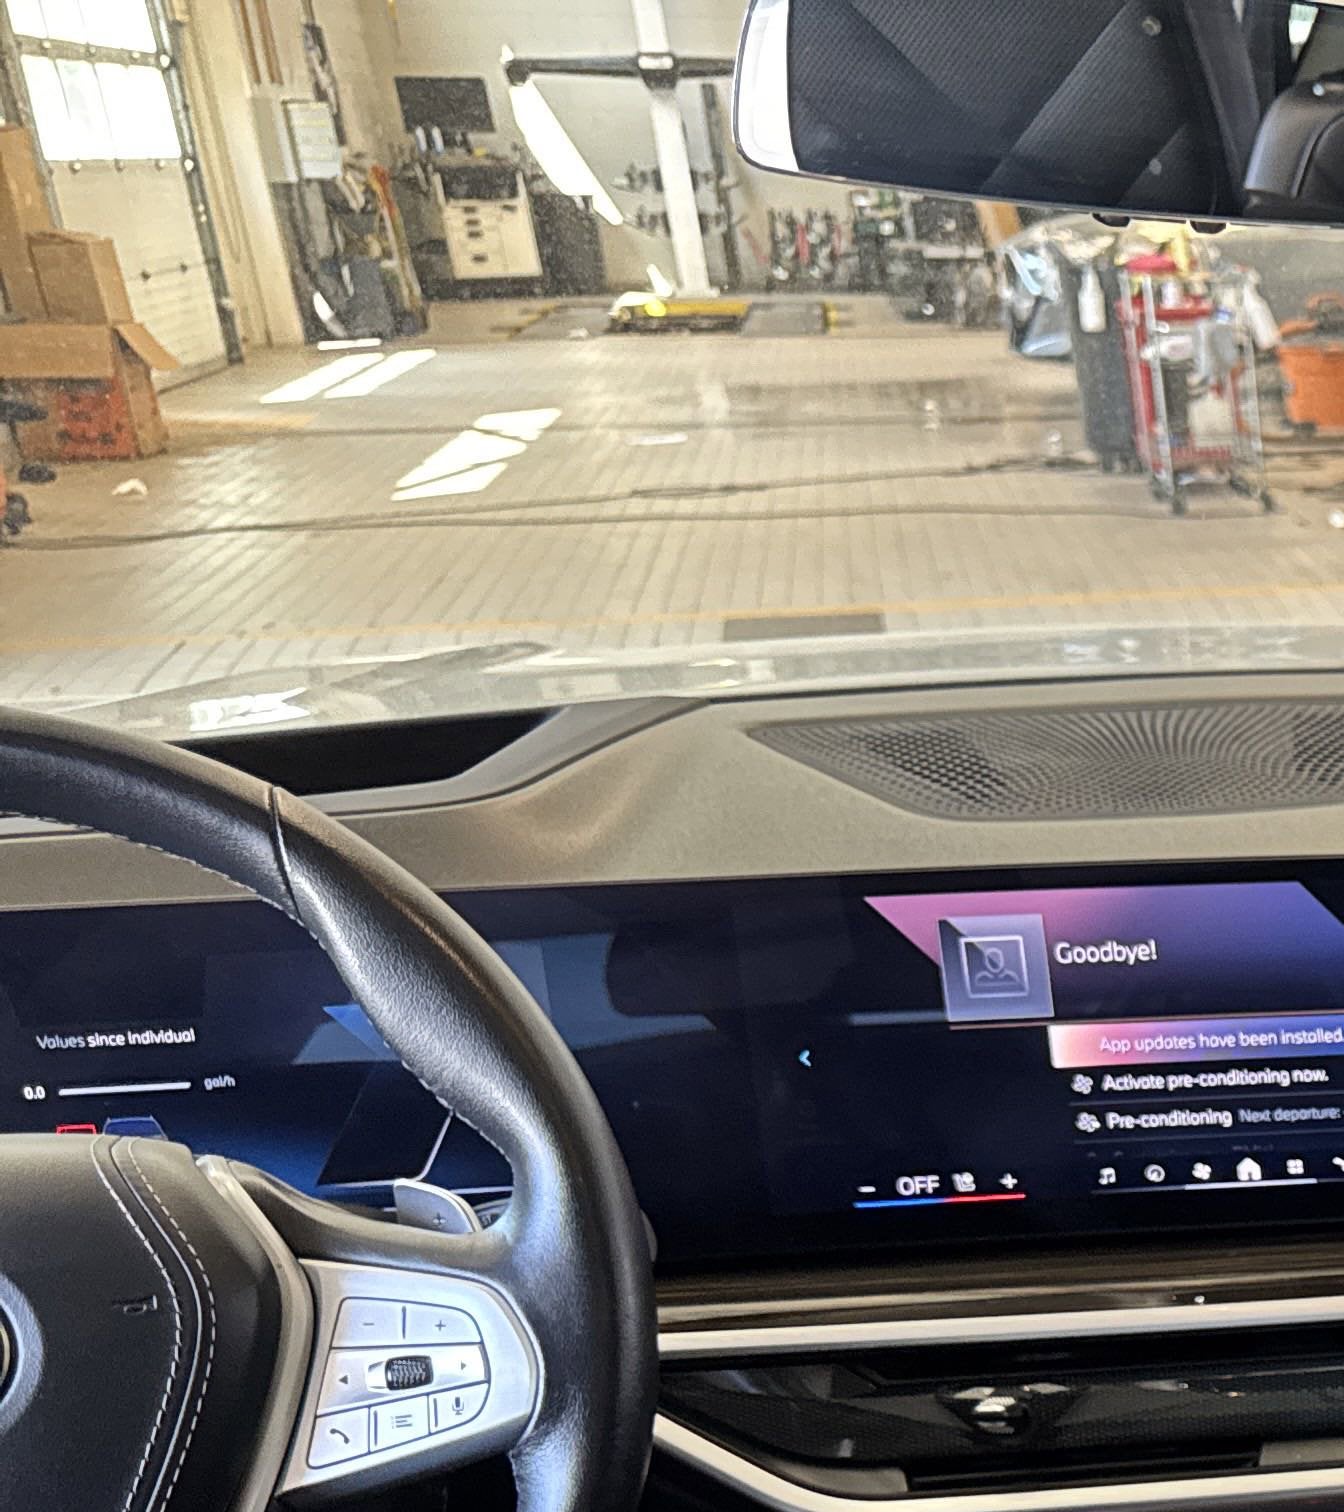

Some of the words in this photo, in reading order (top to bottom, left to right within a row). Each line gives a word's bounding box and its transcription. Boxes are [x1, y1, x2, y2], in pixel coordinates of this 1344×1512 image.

[1054, 938, 1158, 966] Goodbye!
[35, 1034, 86, 1050] Values
[86, 1032, 126, 1048] since
[127, 1027, 196, 1046] individual
[1099, 1036, 1132, 1053] App
[1134, 1032, 1197, 1052] updates
[1199, 1030, 1236, 1048] have
[1239, 1029, 1279, 1047] been
[1102, 1073, 1166, 1092] Activate
[1167, 1067, 1292, 1092] pre-conditioning
[1292, 1068, 1330, 1083] now.
[23, 1084, 46, 1101] 0.0
[1104, 1107, 1233, 1130] Pre-conditioning
[1238, 1107, 1274, 1124] Next
[1273, 1105, 1342, 1124] departure:
[895, 1174, 941, 1197] OFF
